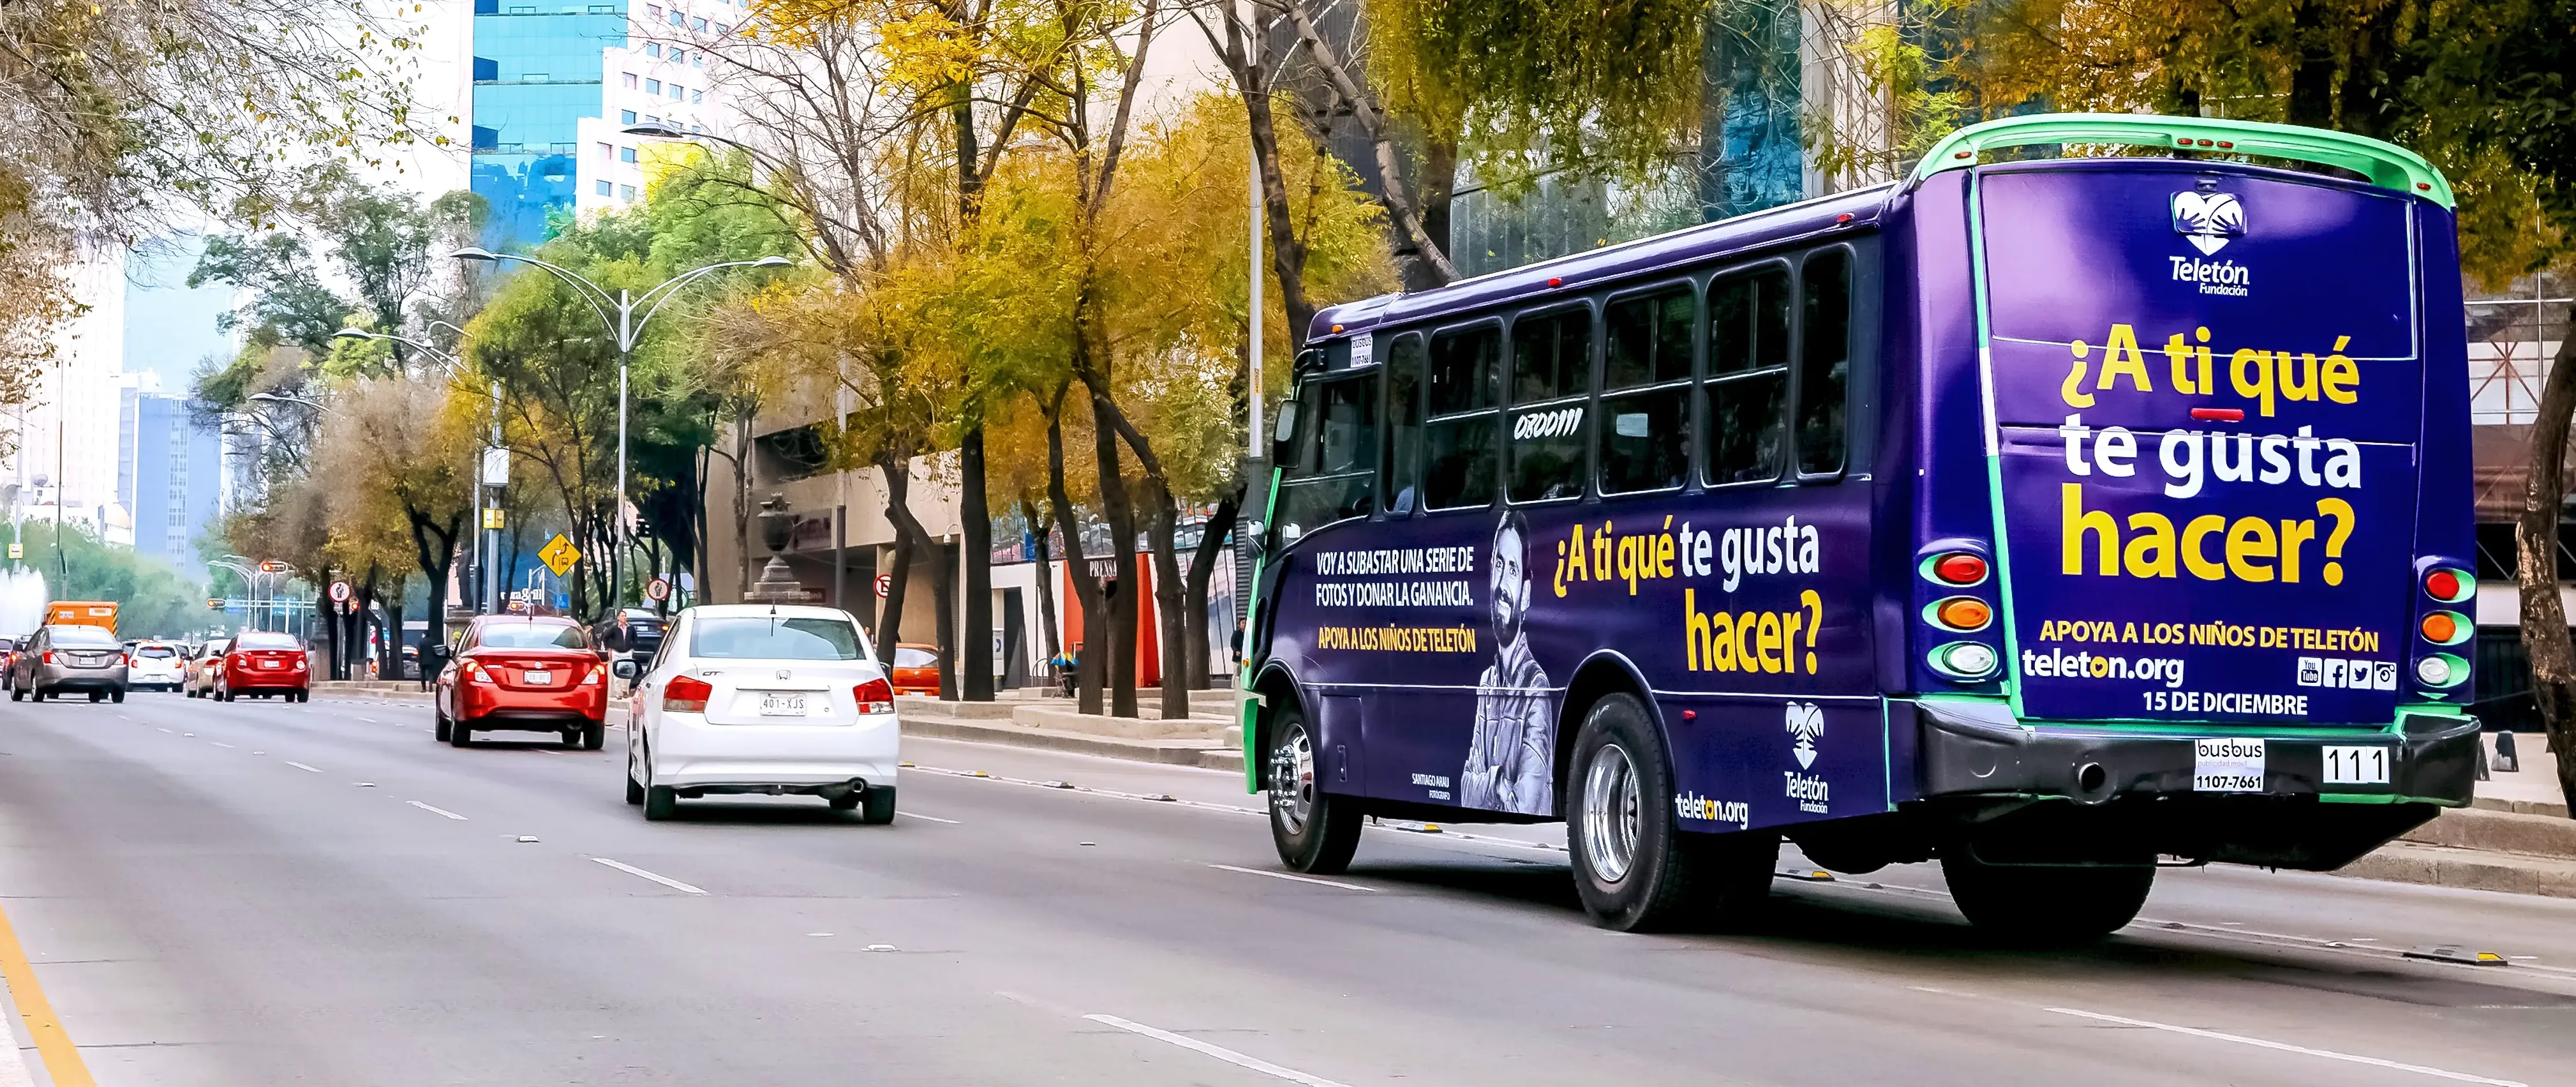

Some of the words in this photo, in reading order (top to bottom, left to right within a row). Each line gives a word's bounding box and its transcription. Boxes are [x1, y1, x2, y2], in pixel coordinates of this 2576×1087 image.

[2170, 256, 2249, 285] Teletón
[2200, 283, 2247, 296] Fundación
[2061, 324, 2152, 408] ¿A
[2164, 326, 2213, 394] ti
[2230, 336, 2360, 417] qué
[1514, 407, 1583, 440] 0800111
[2059, 413, 2138, 477] te
[2159, 425, 2361, 499] gusta
[2062, 483, 2355, 586] hacer?
[1317, 551, 1337, 575] VOY
[1337, 552, 1345, 574] A
[1346, 550, 1399, 574] SUBASTAR
[1401, 549, 1424, 573] UNA
[1426, 548, 1456, 573] SERIE
[1458, 546, 1474, 572] DE
[1554, 524, 1588, 598] ¿A
[1593, 520, 1612, 581] ti
[1618, 514, 1675, 596] qué
[1679, 521, 1713, 576] te
[1722, 515, 1819, 592] gusta
[1316, 583, 1346, 606] FOTOS
[1348, 583, 1355, 606] Y
[1357, 582, 1394, 606] DONAR
[1396, 582, 1410, 606] LA
[1410, 581, 1473, 606] GANANCIA.
[1318, 627, 1350, 650] APOYA
[1351, 628, 1359, 650] A
[1360, 627, 1378, 650] LOS
[1379, 622, 1411, 651] NIÑOS
[1413, 628, 1427, 652] DE
[1427, 623, 1476, 652] TELETÓN
[1685, 588, 1822, 675] hacer?
[2039, 620, 2117, 643] APOYA
[2122, 622, 2139, 643] A
[2143, 623, 2185, 645] LOS
[2189, 620, 2255, 647] NIÑOS
[2260, 626, 2288, 648] DE
[2290, 627, 2378, 652] TELETÓN
[2022, 647, 2184, 688] teleton.org
[2302, 671, 2318, 682] Tube
[763, 698, 805, 709] 401-XJS
[2143, 692, 2167, 711] 15
[2171, 692, 2200, 711] DE
[2203, 692, 2308, 715] DICIEMBRE
[2198, 738, 2262, 757] busbus
[1412, 773, 1436, 786] SANTIAGO
[1784, 771, 1829, 801] Teletón
[2197, 776, 2260, 788] 1107-7661
[1675, 790, 1748, 830] teleton.org
[1800, 799, 1828, 814] Fundación
